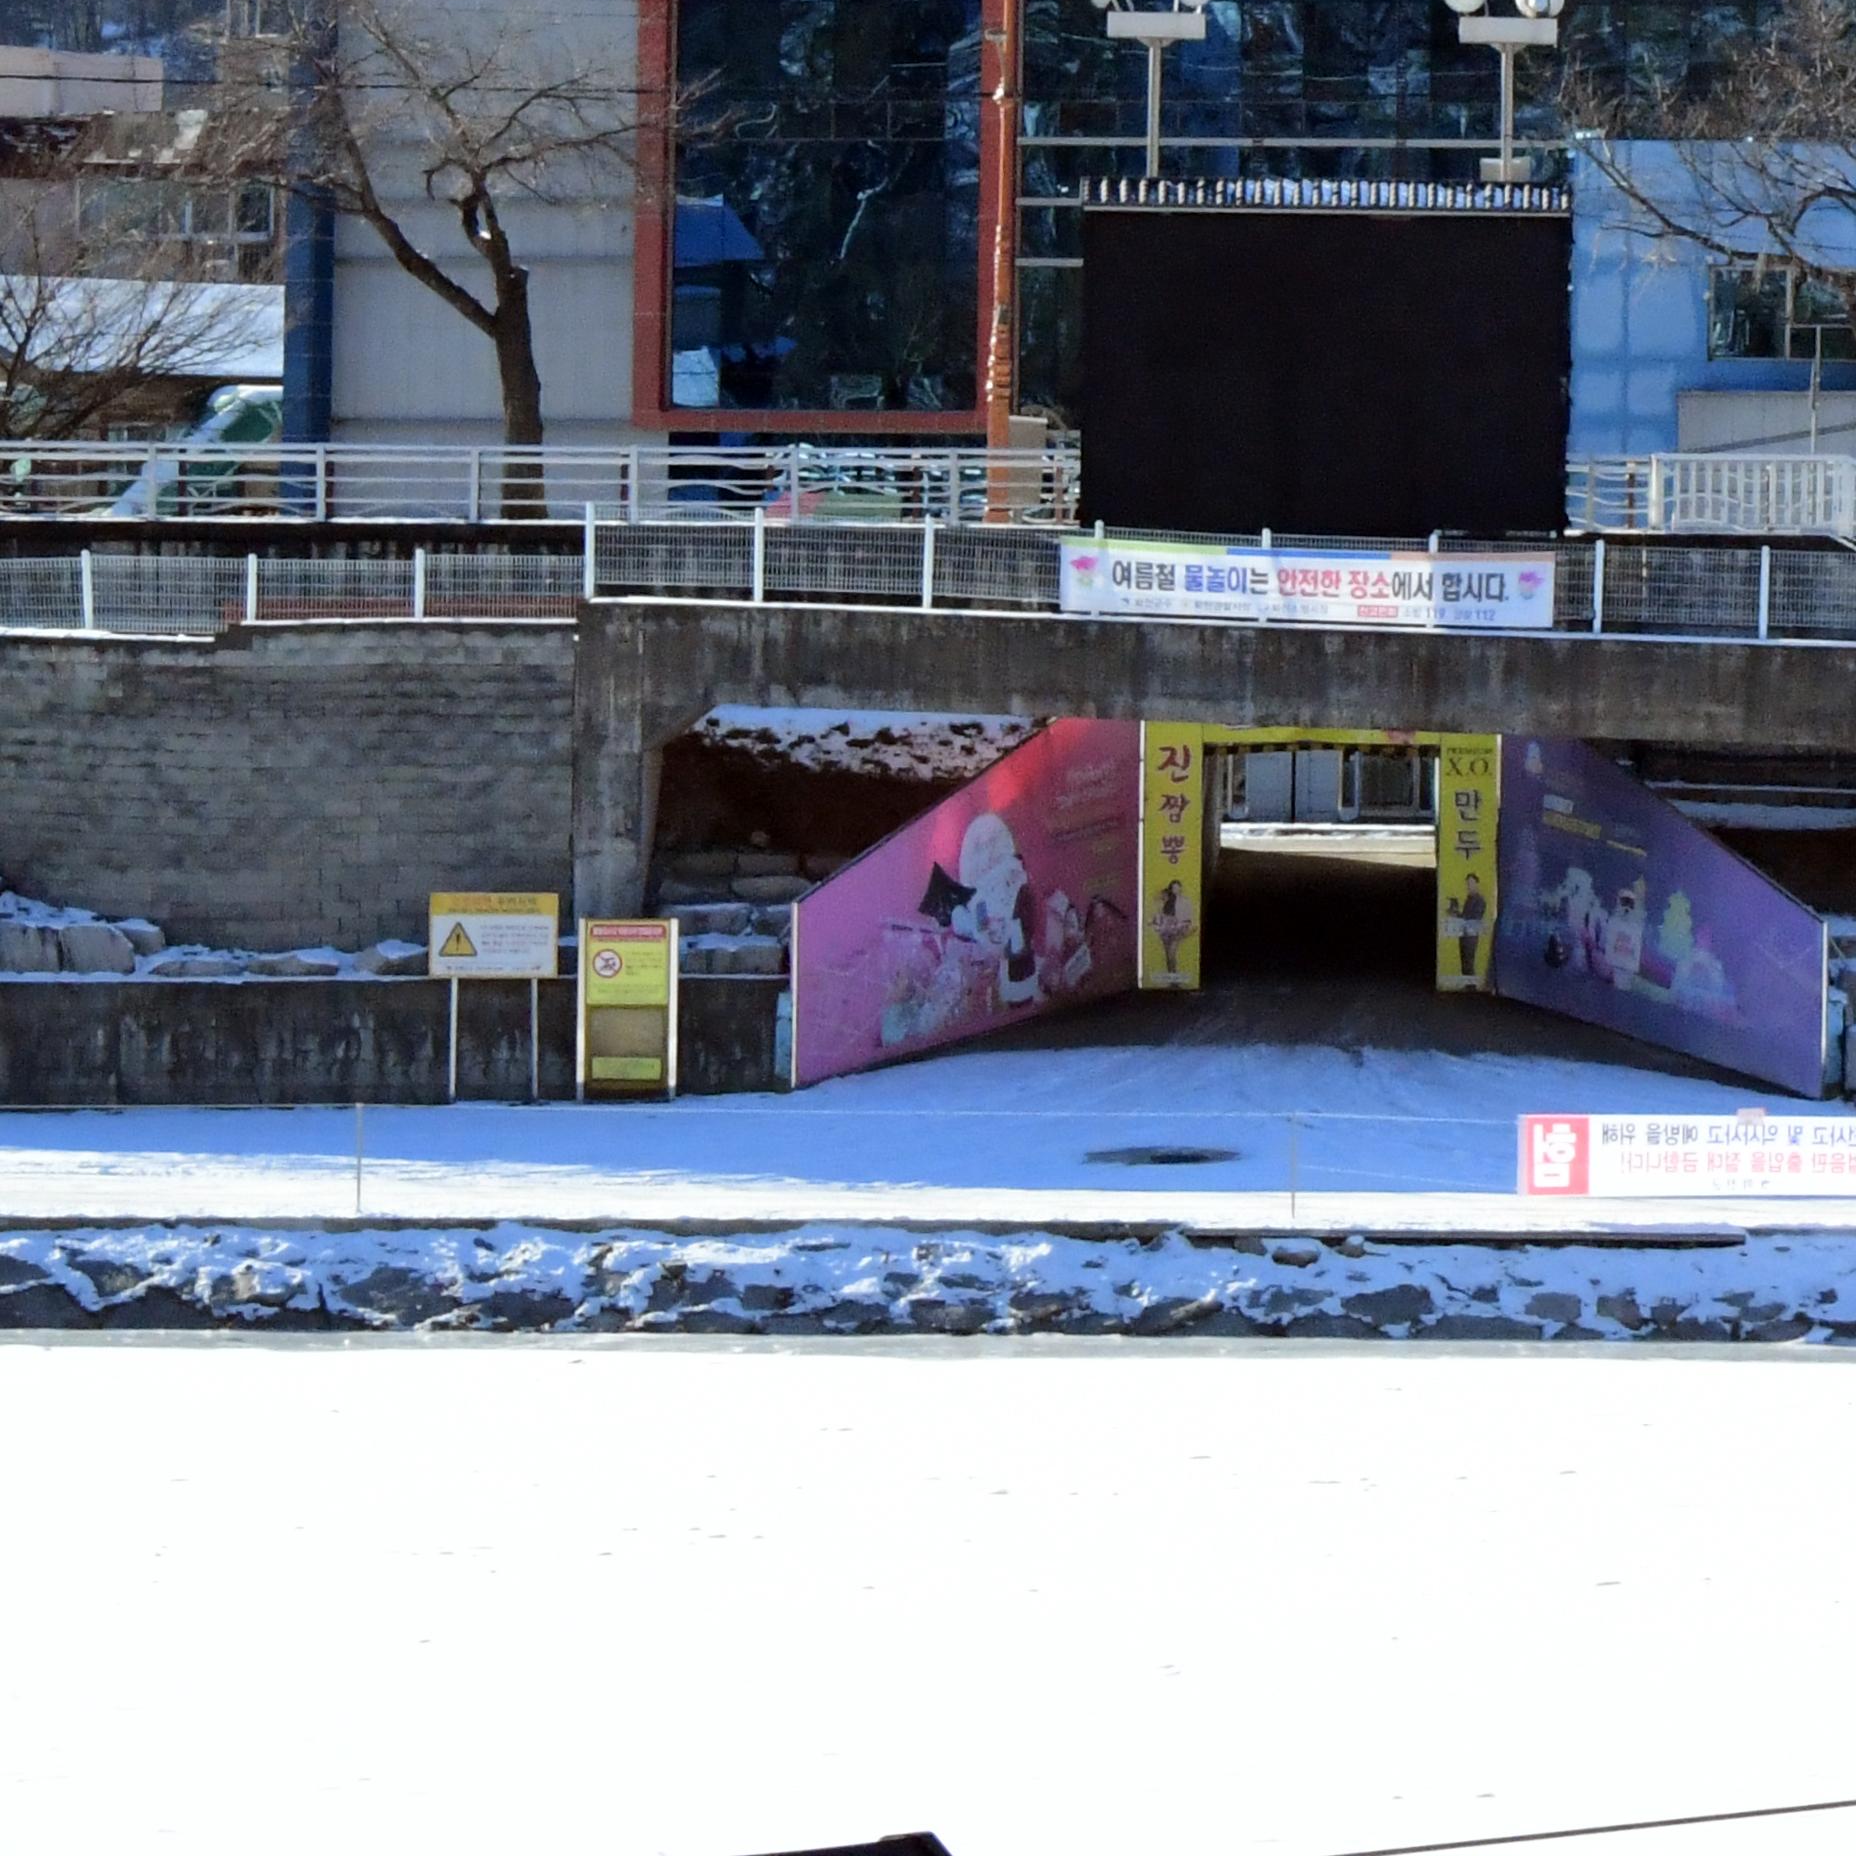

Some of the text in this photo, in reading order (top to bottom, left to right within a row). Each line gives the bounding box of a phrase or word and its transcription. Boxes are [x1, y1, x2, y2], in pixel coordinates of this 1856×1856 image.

[1113, 560, 1509, 602] 여름철 물놀이는 안전한 장소에서 합시다.
[1426, 607, 1446, 620] 119
[1475, 608, 1496, 621] 112
[1455, 790, 1481, 860] 만두
